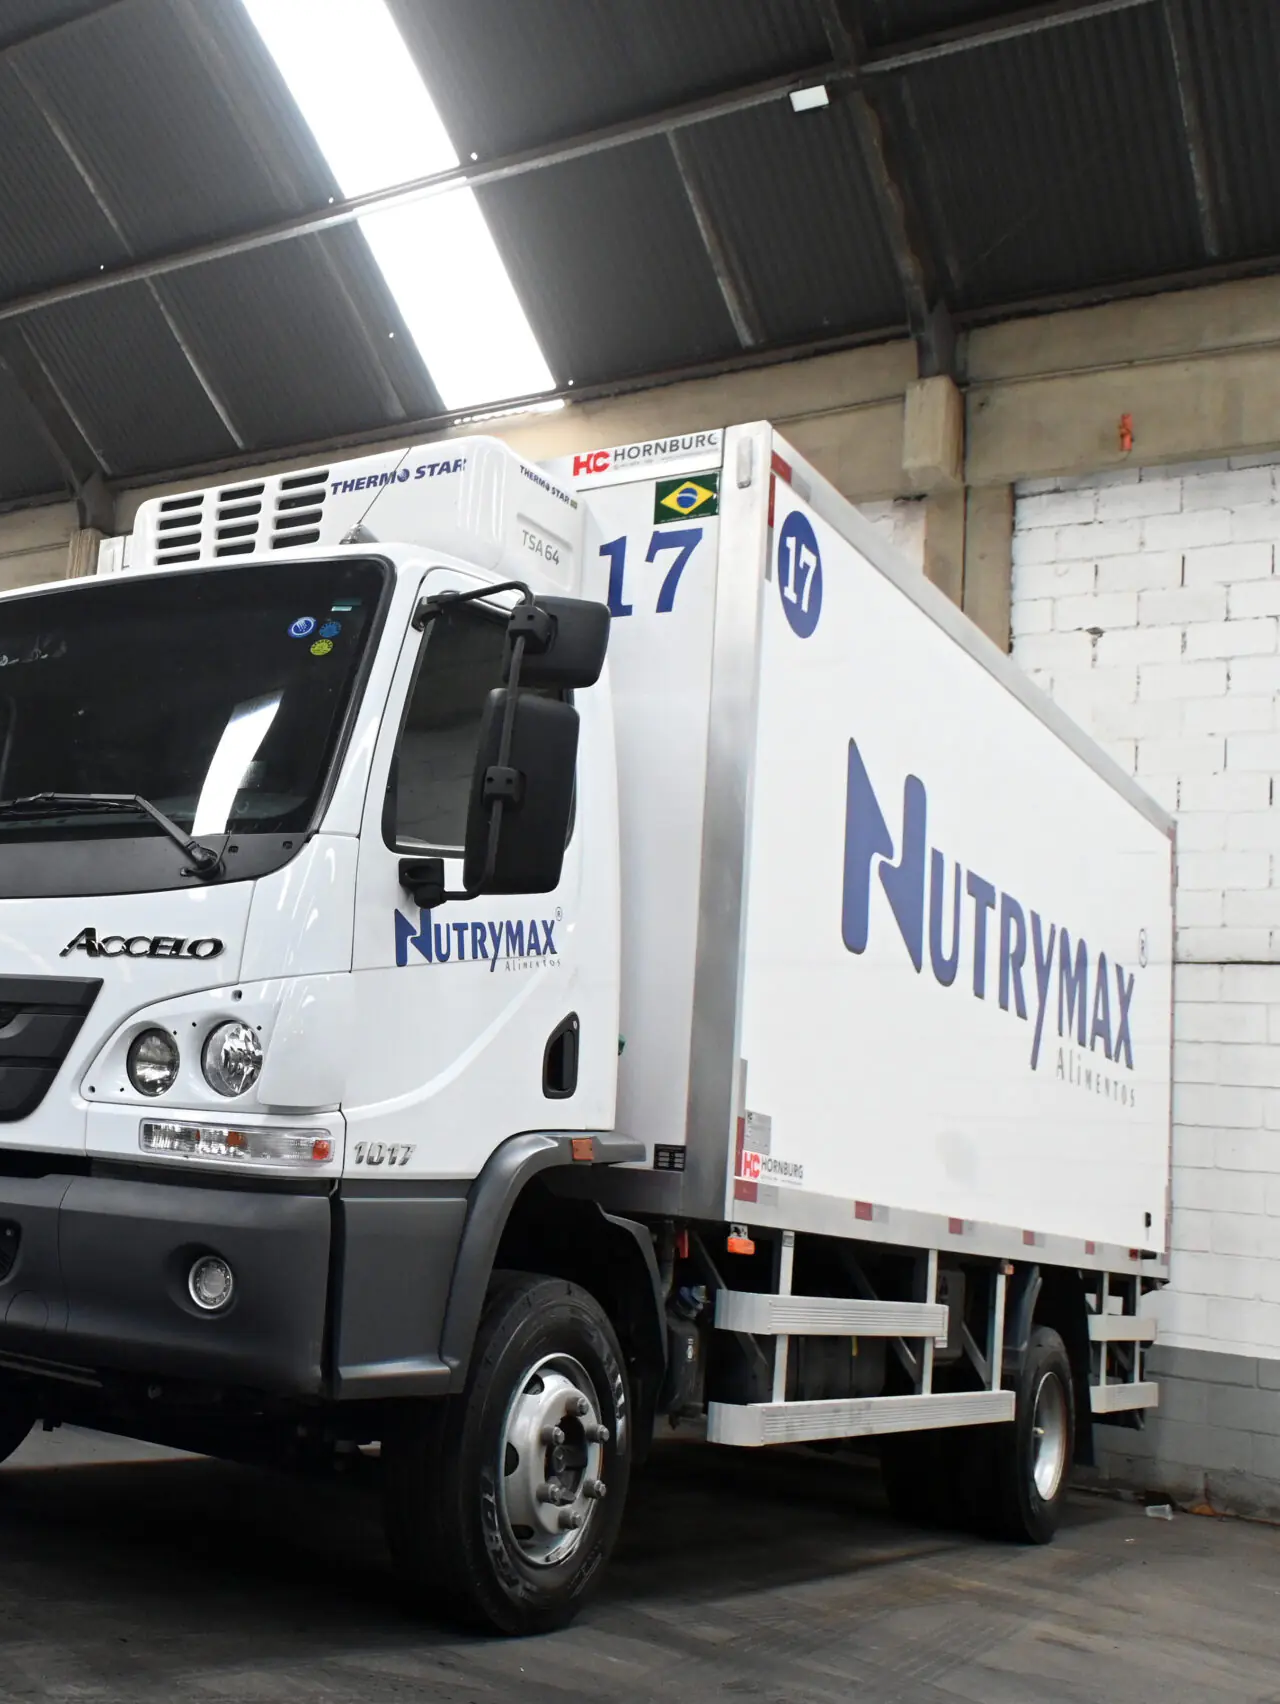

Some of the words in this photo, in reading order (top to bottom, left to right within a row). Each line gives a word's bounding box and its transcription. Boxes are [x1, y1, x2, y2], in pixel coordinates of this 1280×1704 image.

[330, 468, 410, 496] THERMO
[413, 458, 467, 480] STAR
[573, 451, 610, 476] HC
[519, 465, 550, 492] THERMO
[551, 486, 571, 505] STAR
[522, 529, 543, 556] TSA
[544, 546, 561, 566] 64
[599, 527, 704, 618] 17
[783, 536, 817, 613] 17
[842, 736, 1135, 1071] NUTRYMAX
[394, 907, 558, 973] NUTRYMAX
[354, 1141, 417, 1166] 1017
[743, 1152, 761, 1179] HC
[761, 1155, 804, 1180] HORNBURG
